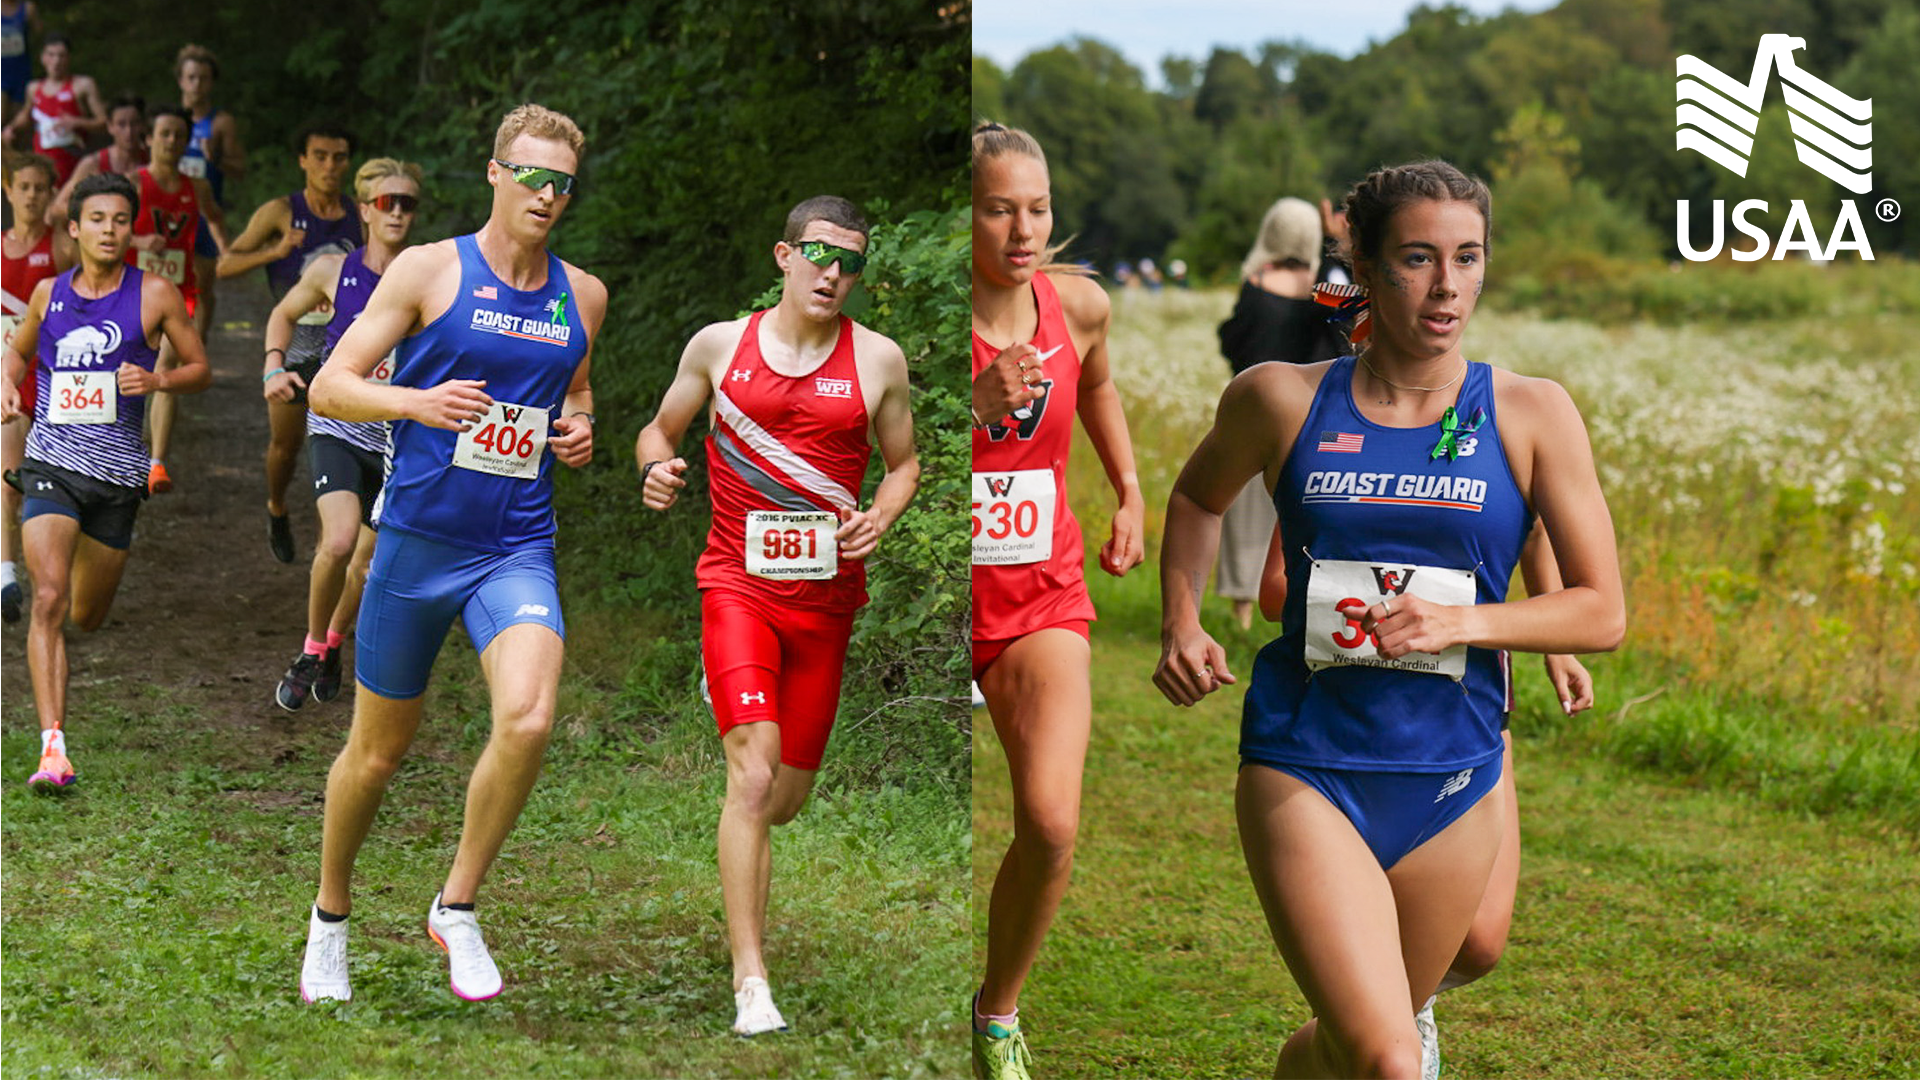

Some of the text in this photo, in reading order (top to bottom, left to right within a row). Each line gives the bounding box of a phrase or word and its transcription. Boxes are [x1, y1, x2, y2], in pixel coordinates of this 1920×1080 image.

[472, 309, 571, 341] COAST GUARD
[59, 388, 104, 410] 364
[815, 380, 852, 396] WPI
[473, 423, 535, 458] 406
[1305, 471, 1487, 503] COAST GUARD
[972, 500, 1038, 540] 530
[763, 529, 816, 560] 981
[972, 542, 1036, 554] sleyan Cardinal
[973, 554, 1021, 563] Invitational
[760, 566, 824, 575] CHAMPIONSHIP
[1332, 653, 1440, 671] Wesleyan Cardinal
